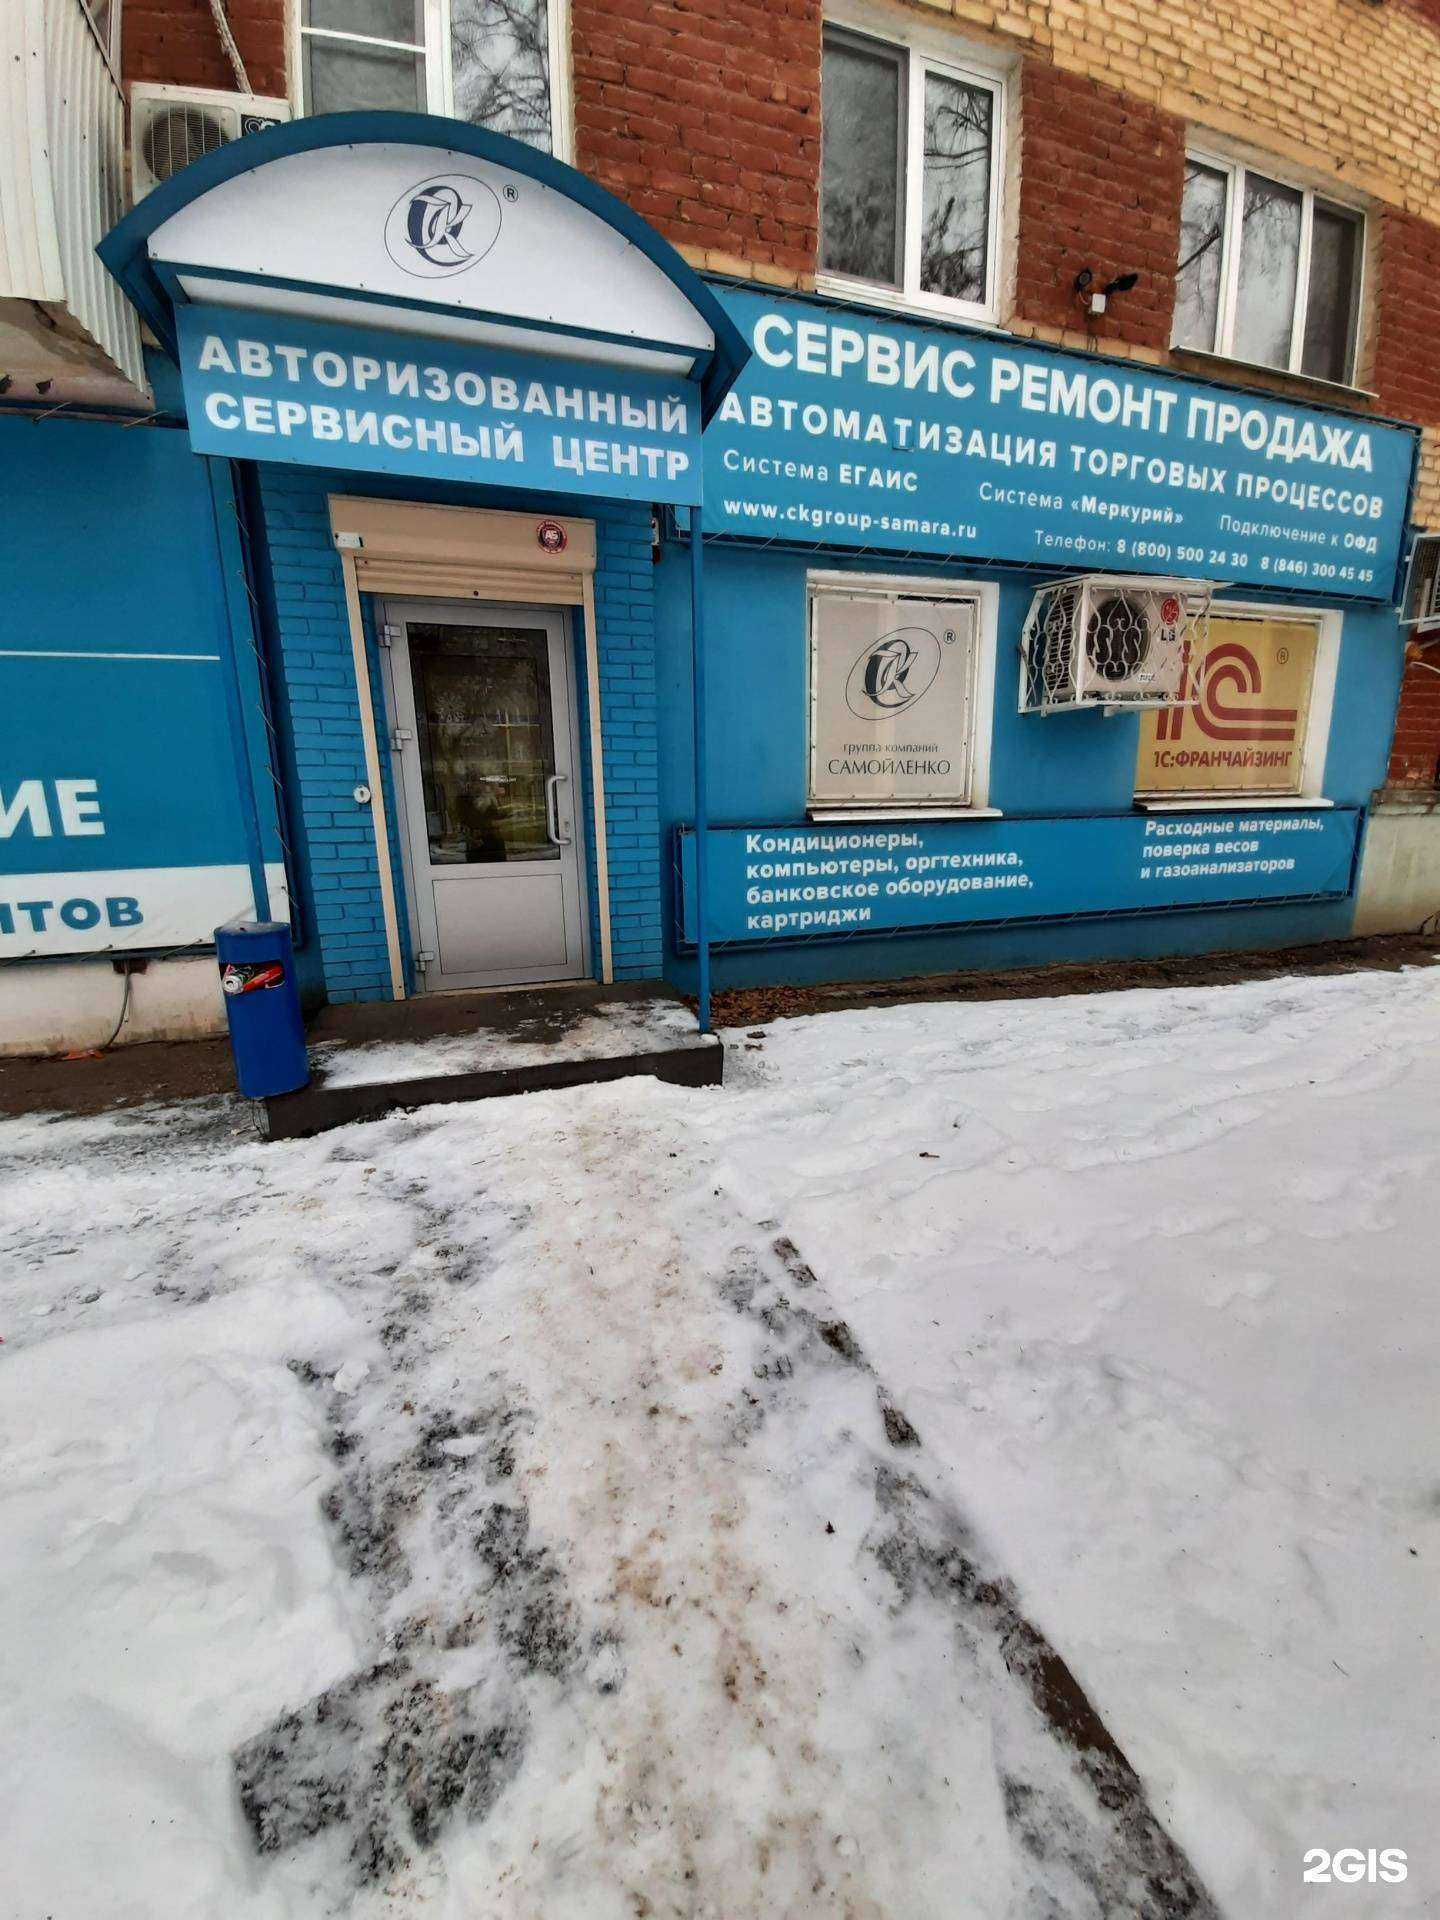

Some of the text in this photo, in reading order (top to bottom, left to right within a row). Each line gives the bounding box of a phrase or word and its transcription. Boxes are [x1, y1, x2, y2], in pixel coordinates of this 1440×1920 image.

[199, 336, 688, 435] АВТОРИЗОВАННЫЙ
[753, 314, 1373, 473] СЕРВИС РЕМОНТ ПРОДАЖА
[205, 392, 689, 481] СЕРВИСНЫЙ ЦЕНТР
[719, 392, 1383, 520] АВТОМАТИЗАЦИЯ ТОРГОВЫХ ПРОЦЕССОВ
[723, 449, 918, 492] Система ЕГАИС
[724, 499, 977, 539] www.ckgroup-samara.ru
[979, 482, 1184, 525] Система «Меркурий»
[1220, 514, 1378, 555] Подключение к ОФД
[1035, 530, 1373, 583] Телефон: 8 (800) 500 24 30 8 (846) 300 45 45
[843, 742, 939, 756] группа компаний
[1154, 747, 1293, 768] 1С:ФРАНЧАЙЗИНГ
[828, 757, 951, 775] САМОЙЛЕНКО
[746, 832, 924, 854] Кондиционеры,
[1145, 818, 1325, 837] Расходные материалы,
[746, 851, 1023, 879] компьютеры, оргтехника,
[1142, 840, 1260, 859] поверка весов
[1140, 858, 1296, 880] и газоанализаторов
[746, 873, 1034, 905] банковское оборудование,
[747, 905, 872, 931] картриджи
